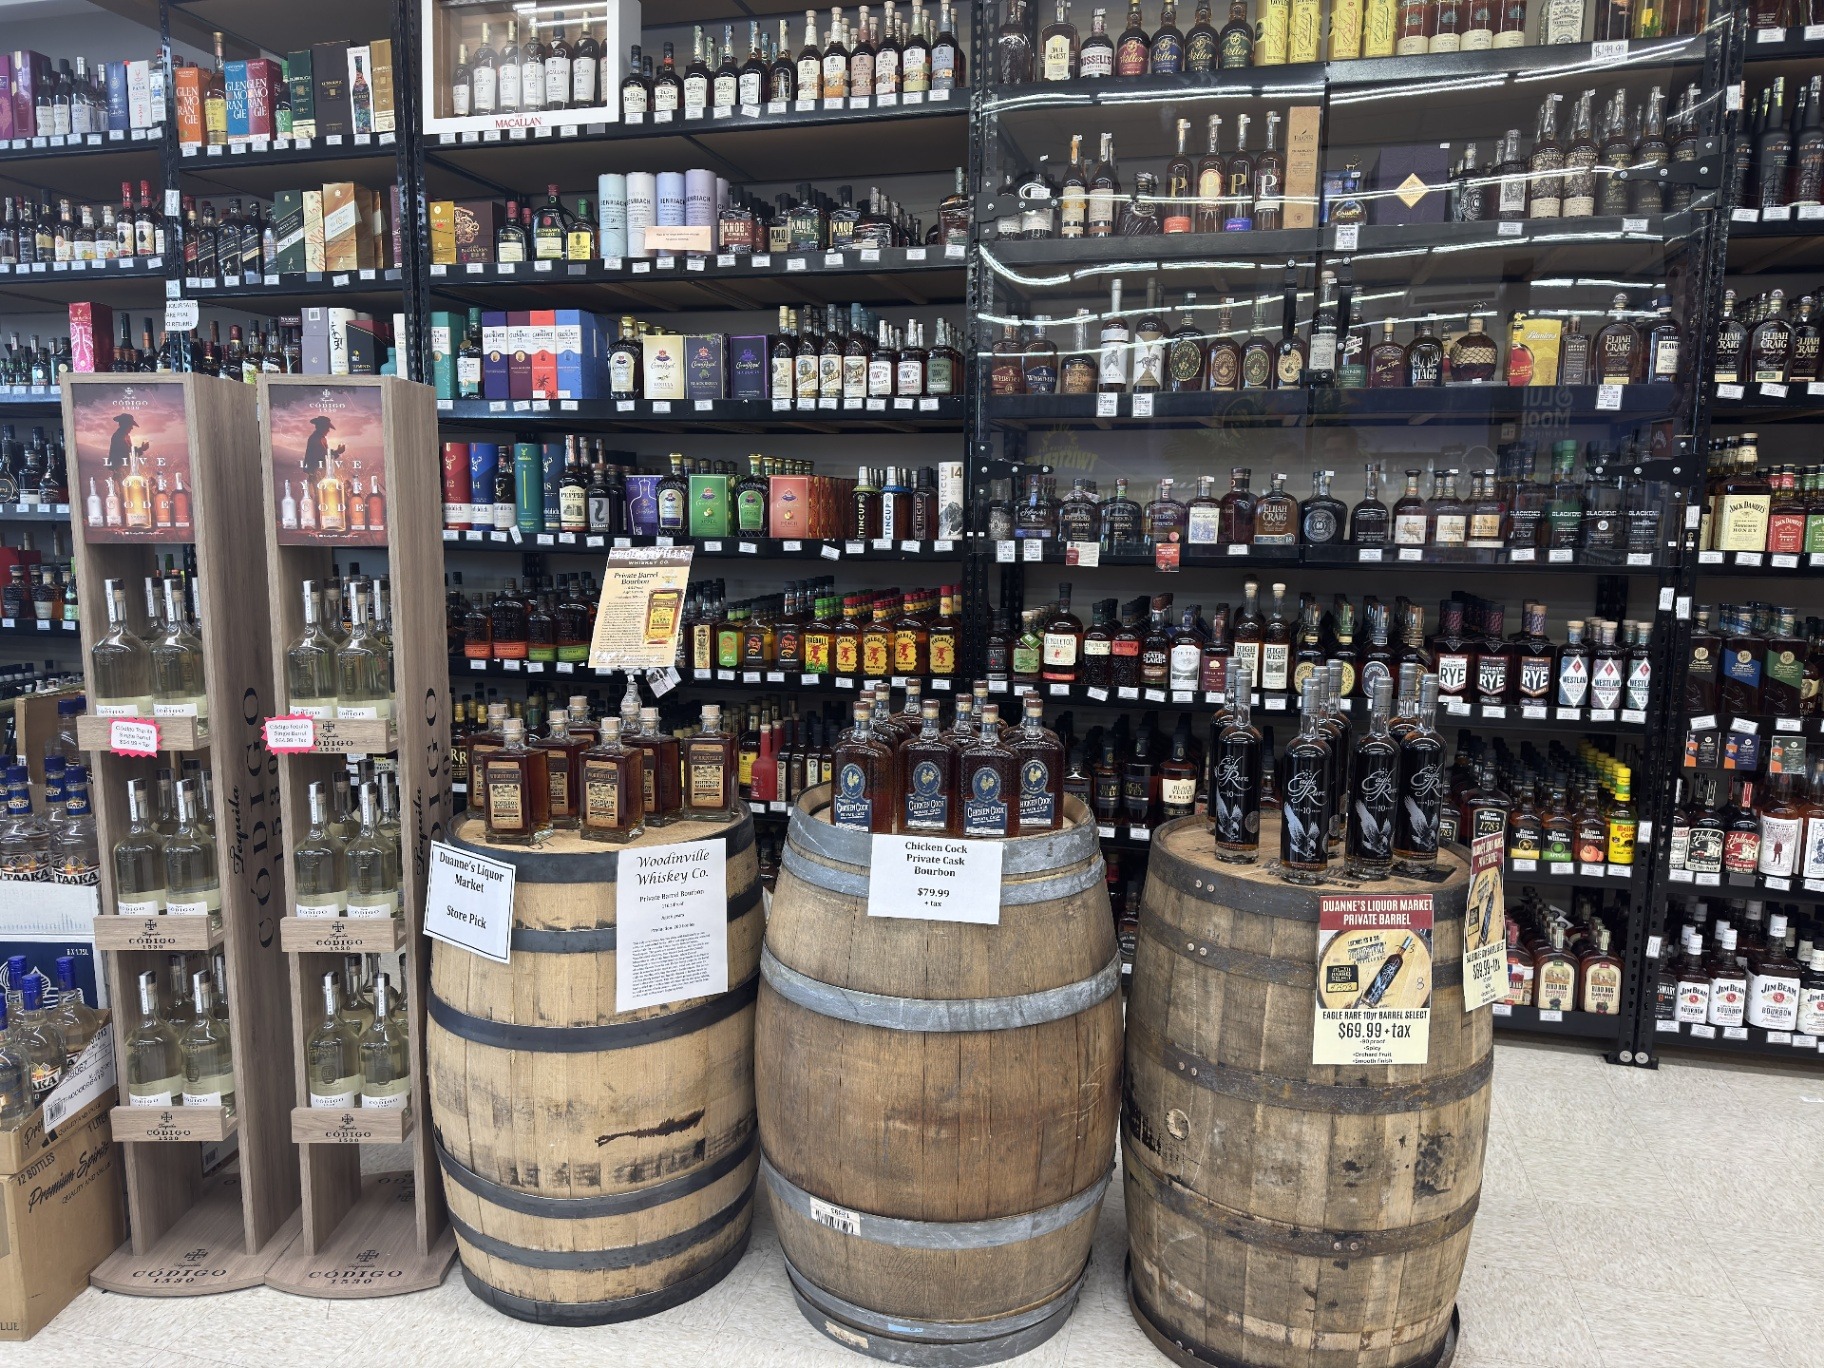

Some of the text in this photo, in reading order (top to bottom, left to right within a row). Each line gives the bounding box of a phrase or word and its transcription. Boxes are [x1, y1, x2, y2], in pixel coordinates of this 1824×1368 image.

[226, 80, 247, 90] GLEN
[247, 78, 266, 87] GLEN
[176, 86, 198, 96] GLEN
[234, 91, 247, 100] MO
[253, 88, 268, 97] MO
[184, 96, 199, 105] MO
[226, 100, 243, 109] RAN
[248, 98, 263, 107] RAN
[177, 106, 195, 115] RAN
[234, 109, 247, 119] GIE
[254, 106, 267, 117] GIE
[185, 115, 198, 124] GIE
[495, 117, 543, 128] MACALLAN
[1171, 177, 1188, 197] P
[1204, 176, 1217, 197] P
[1231, 174, 1246, 195] P
[1261, 174, 1277, 195] P
[724, 222, 745, 232] KNOB
[791, 219, 812, 230] KNOB
[833, 221, 853, 231] KNOB
[1606, 335, 1631, 344] ELIJAH
[1762, 332, 1789, 340] ELIJAH
[1605, 343, 1631, 352] CRAIG
[1761, 339, 1787, 348] CRAIG
[1412, 368, 1437, 380] STAGG
[112, 399, 148, 407] CÓDIGO
[309, 401, 346, 409] CÓDIGO
[103, 456, 167, 467] LIVE
[300, 459, 363, 469] LIVE
[951, 466, 962, 478] 14
[105, 479, 168, 489] YOUR
[300, 480, 364, 491] YOUR
[472, 482, 481, 490] 14
[107, 500, 170, 510] CODE
[301, 502, 366, 512] CODE
[1262, 504, 1287, 514] ELIJAH
[1729, 501, 1766, 513] JACK DANIEL'S
[858, 502, 866, 535] TINCUP
[1262, 512, 1287, 521] CRAIG
[806, 636, 828, 645] FIREBALL
[1237, 645, 1256, 653] HIGH
[1440, 668, 1465, 686] RYE
[1480, 674, 1504, 691] RYE
[1522, 670, 1548, 690] RYE
[1595, 678, 1621, 687] WESTLAND
[1361, 767, 1395, 794] Eagle
[1410, 763, 1444, 789] Eagle
[1288, 770, 1322, 796] Eagle
[1291, 785, 1328, 806] Rare
[1366, 783, 1398, 802] Rare
[1303, 807, 1311, 815] 10
[243, 688, 274, 948] CÓDIGO
[230, 785, 248, 874] Tequila
[413, 786, 428, 875] Tequila
[1479, 821, 1500, 831] 1783
[905, 842, 968, 854] Chicken Cock
[637, 849, 709, 868] Woodinville
[906, 854, 965, 865] Private Cask
[439, 850, 505, 882] Duanne's Liquor
[914, 866, 956, 877] Bourbon
[3, 869, 49, 883] TAAKA
[55, 871, 97, 884] TAAKA
[635, 868, 709, 885] Whiskey Co.
[454, 874, 484, 894] Market
[917, 888, 950, 898] $79.99
[1323, 899, 1433, 912] DUANNE'S LIQUOR MARKET
[446, 905, 487, 930] Store Pick
[1343, 913, 1411, 926] PRIVATE BARREL
[128, 936, 176, 945] CÓDIGO
[316, 938, 363, 946] CÓDIGO
[1680, 987, 1707, 996] JIM BEAM
[1716, 985, 1745, 994] JIM BEAM
[1761, 982, 1797, 996] JIM BEAM
[1808, 994, 1819, 1002] JIM
[1323, 1010, 1427, 1020] EAGLE RARE 10yr BARREL SELECT
[1762, 1008, 1792, 1016] BOURBON
[1338, 1022, 1382, 1040] $69.99
[1391, 1023, 1411, 1038] tax
[146, 1128, 191, 1136] CÓDIGO
[325, 1129, 371, 1138] CÓDIGO
[17, 1152, 55, 1186] 12 BOTTLES
[28, 1142, 110, 1213] Premium Spirits
[62, 1183, 84, 1204] QUALITY
[132, 1268, 227, 1279] CÓDIGO
[309, 1268, 403, 1280] CÓDIGO
